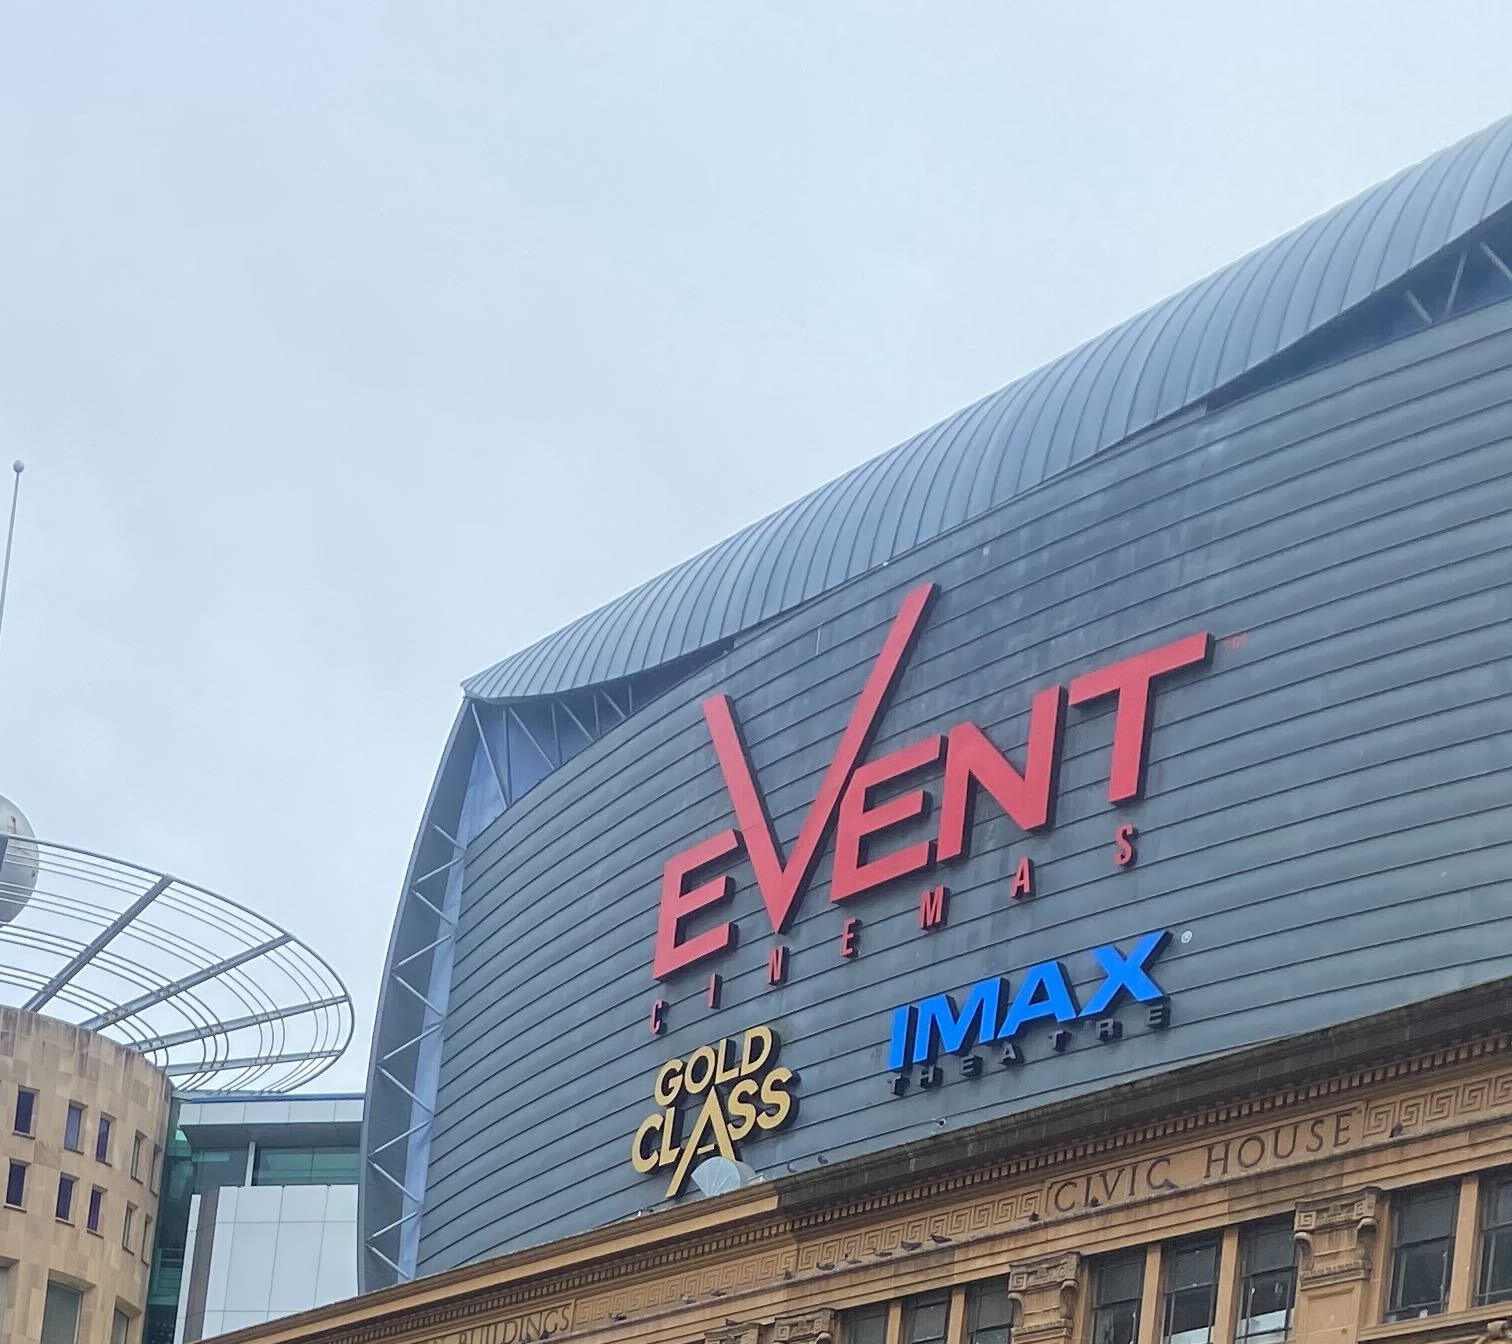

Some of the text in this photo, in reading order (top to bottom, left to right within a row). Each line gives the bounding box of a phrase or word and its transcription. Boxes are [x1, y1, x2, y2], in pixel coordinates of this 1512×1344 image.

[652, 580, 1215, 982] EVENT
[648, 823, 1137, 1036] CINEMAS
[654, 1024, 779, 1107] GOLD
[889, 929, 1175, 1073] IMAX
[890, 1004, 1171, 1096] THEATRE
[631, 1066, 796, 1200] CLASS
[1053, 1110, 1355, 1213] CIVIC HOUSE
